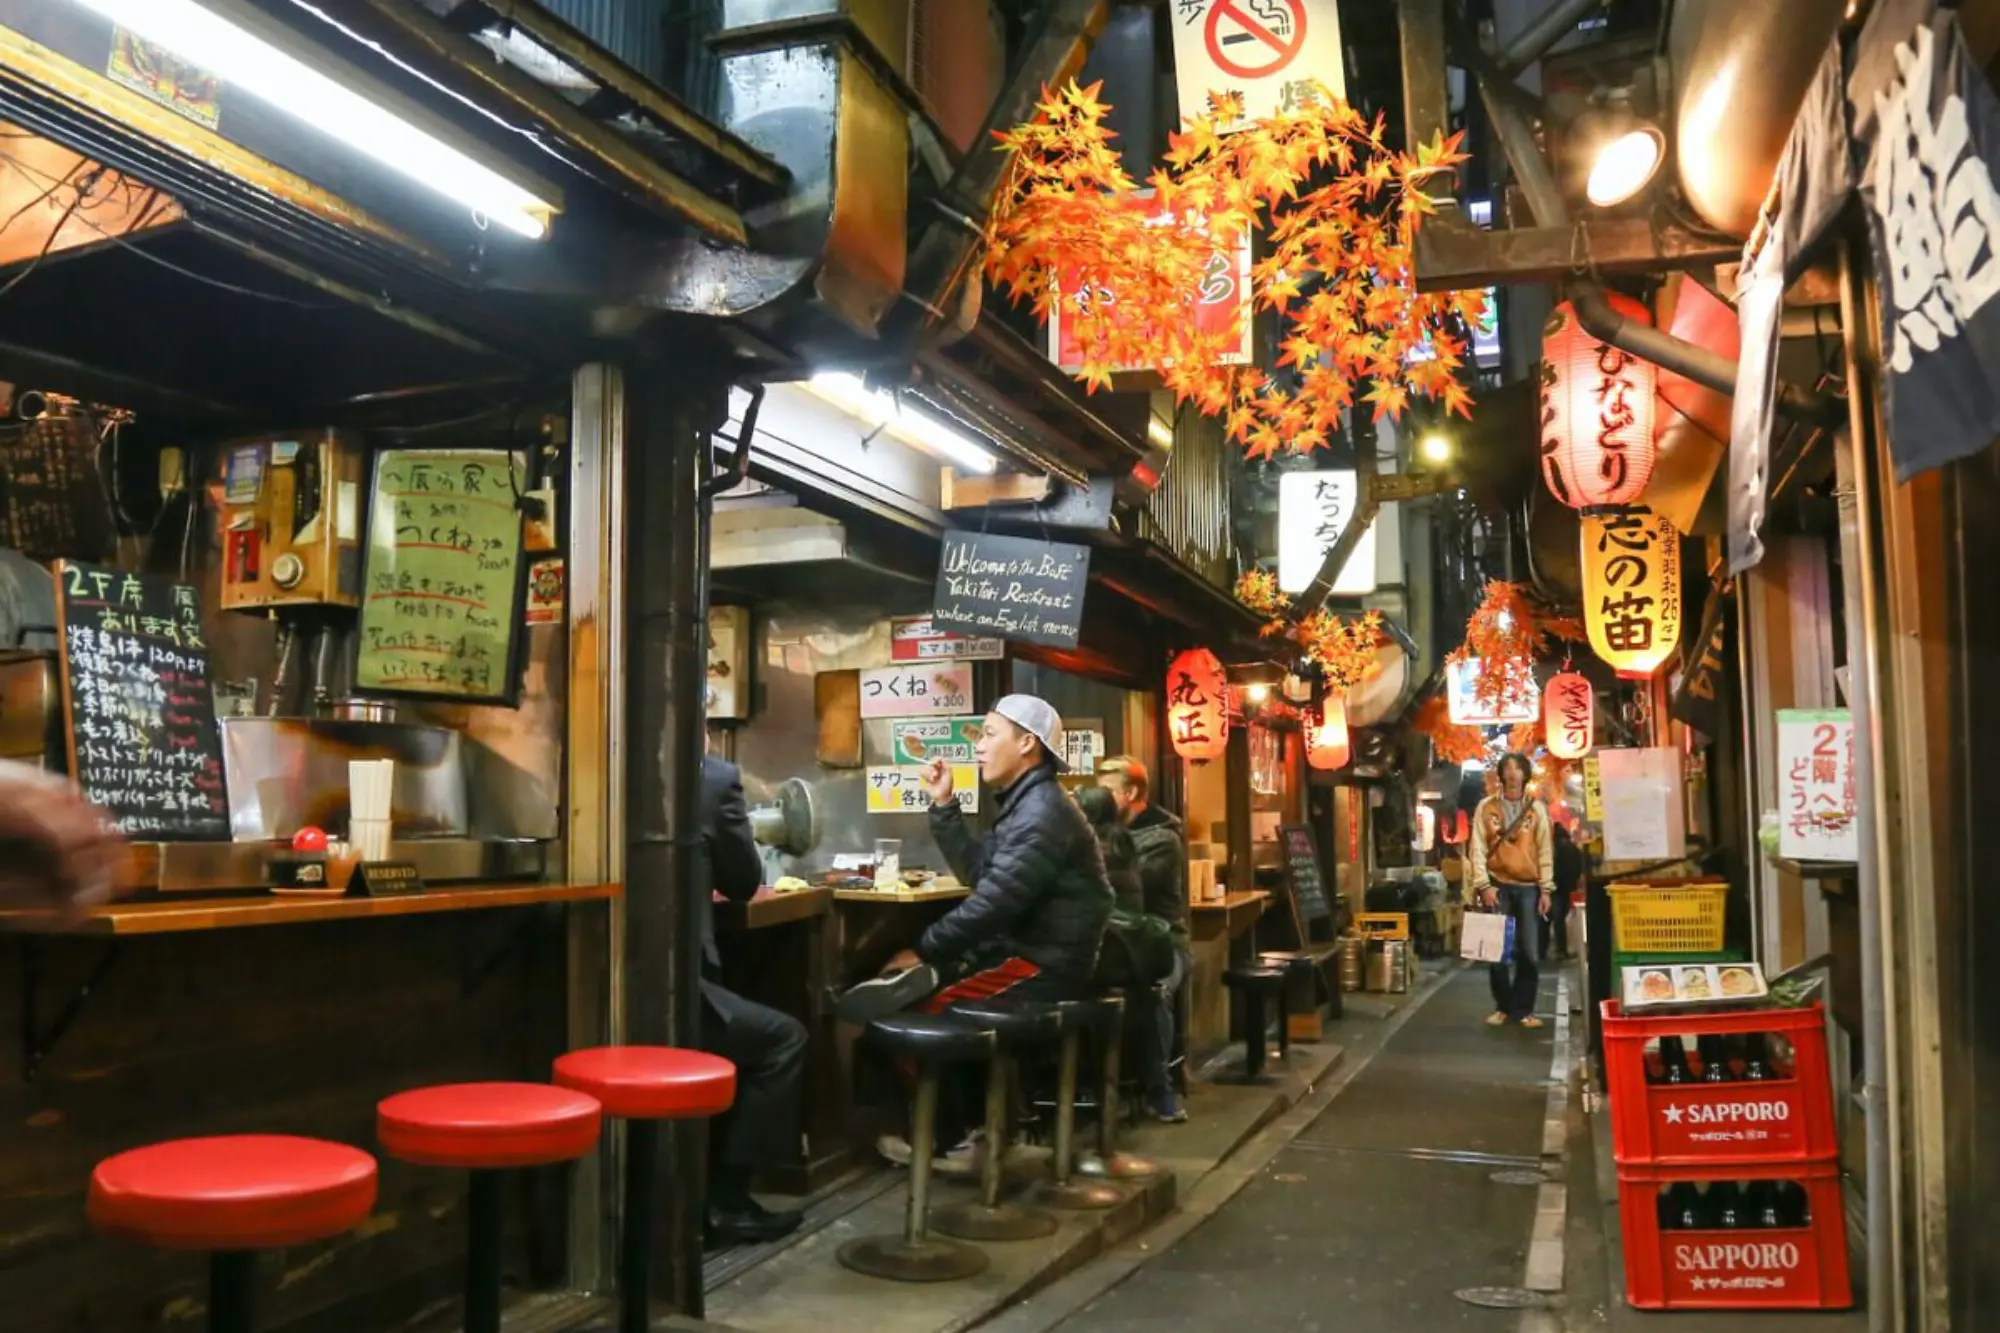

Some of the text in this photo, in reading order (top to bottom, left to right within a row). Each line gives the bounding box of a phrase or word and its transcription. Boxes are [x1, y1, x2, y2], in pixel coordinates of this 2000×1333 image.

[942, 541, 1005, 575] Welcome
[946, 575, 999, 600] Yakitori
[1597, 502, 1657, 652] 志の笛
[97, 607, 181, 648] あります
[863, 673, 927, 698] つくね
[933, 695, 964, 707] ¥300
[1812, 724, 1838, 807] 2階へ
[871, 772, 920, 788] サワー
[1687, 1100, 1790, 1123] SAPPORO
[1675, 1242, 1800, 1270] SAPPORO
